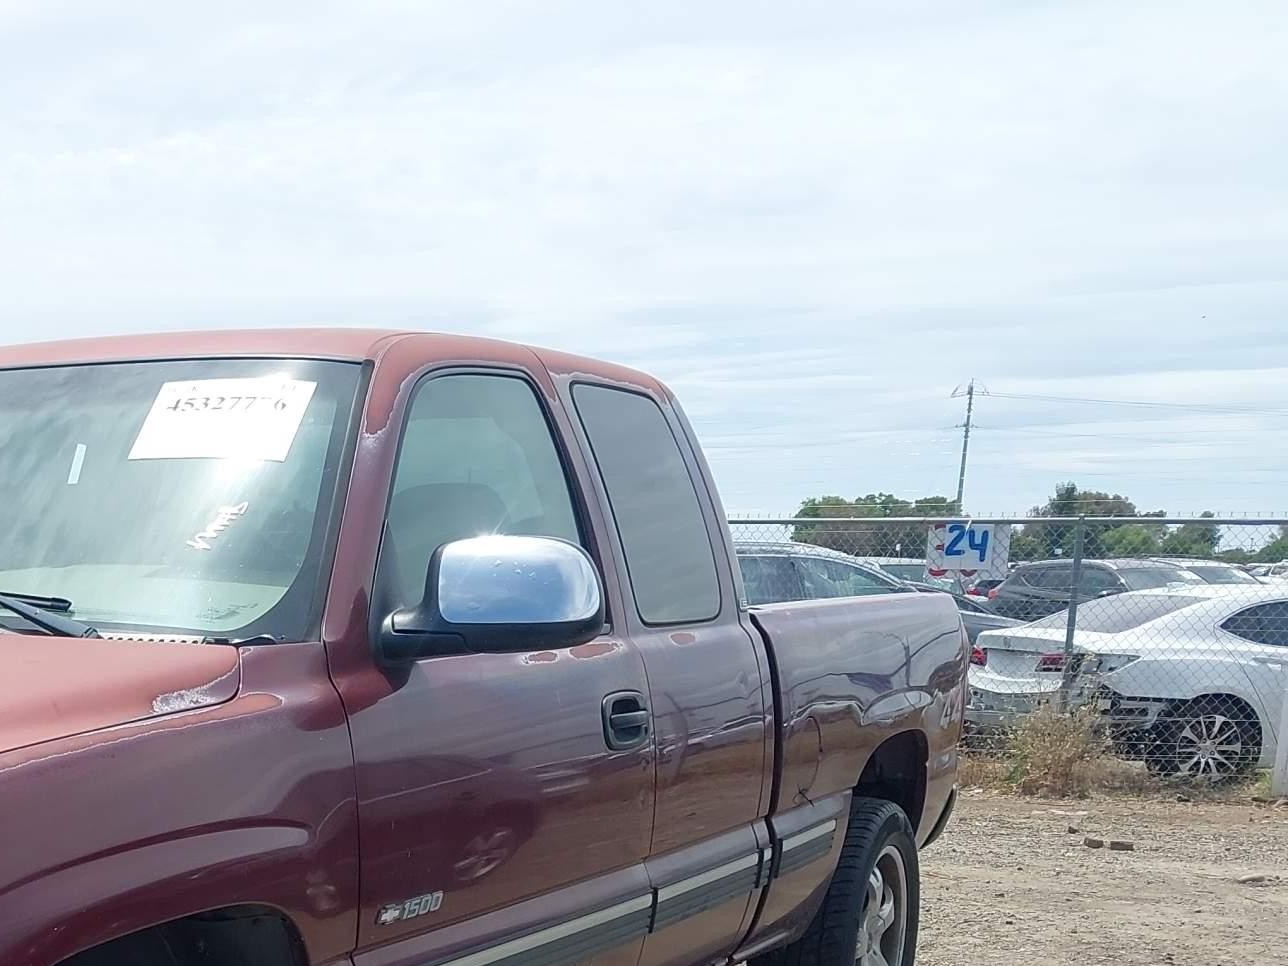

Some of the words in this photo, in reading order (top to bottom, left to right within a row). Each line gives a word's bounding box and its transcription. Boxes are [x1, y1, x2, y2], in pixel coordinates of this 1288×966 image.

[166, 396, 287, 412] 4532776
[945, 524, 989, 562] 24
[402, 890, 443, 920] 1500
